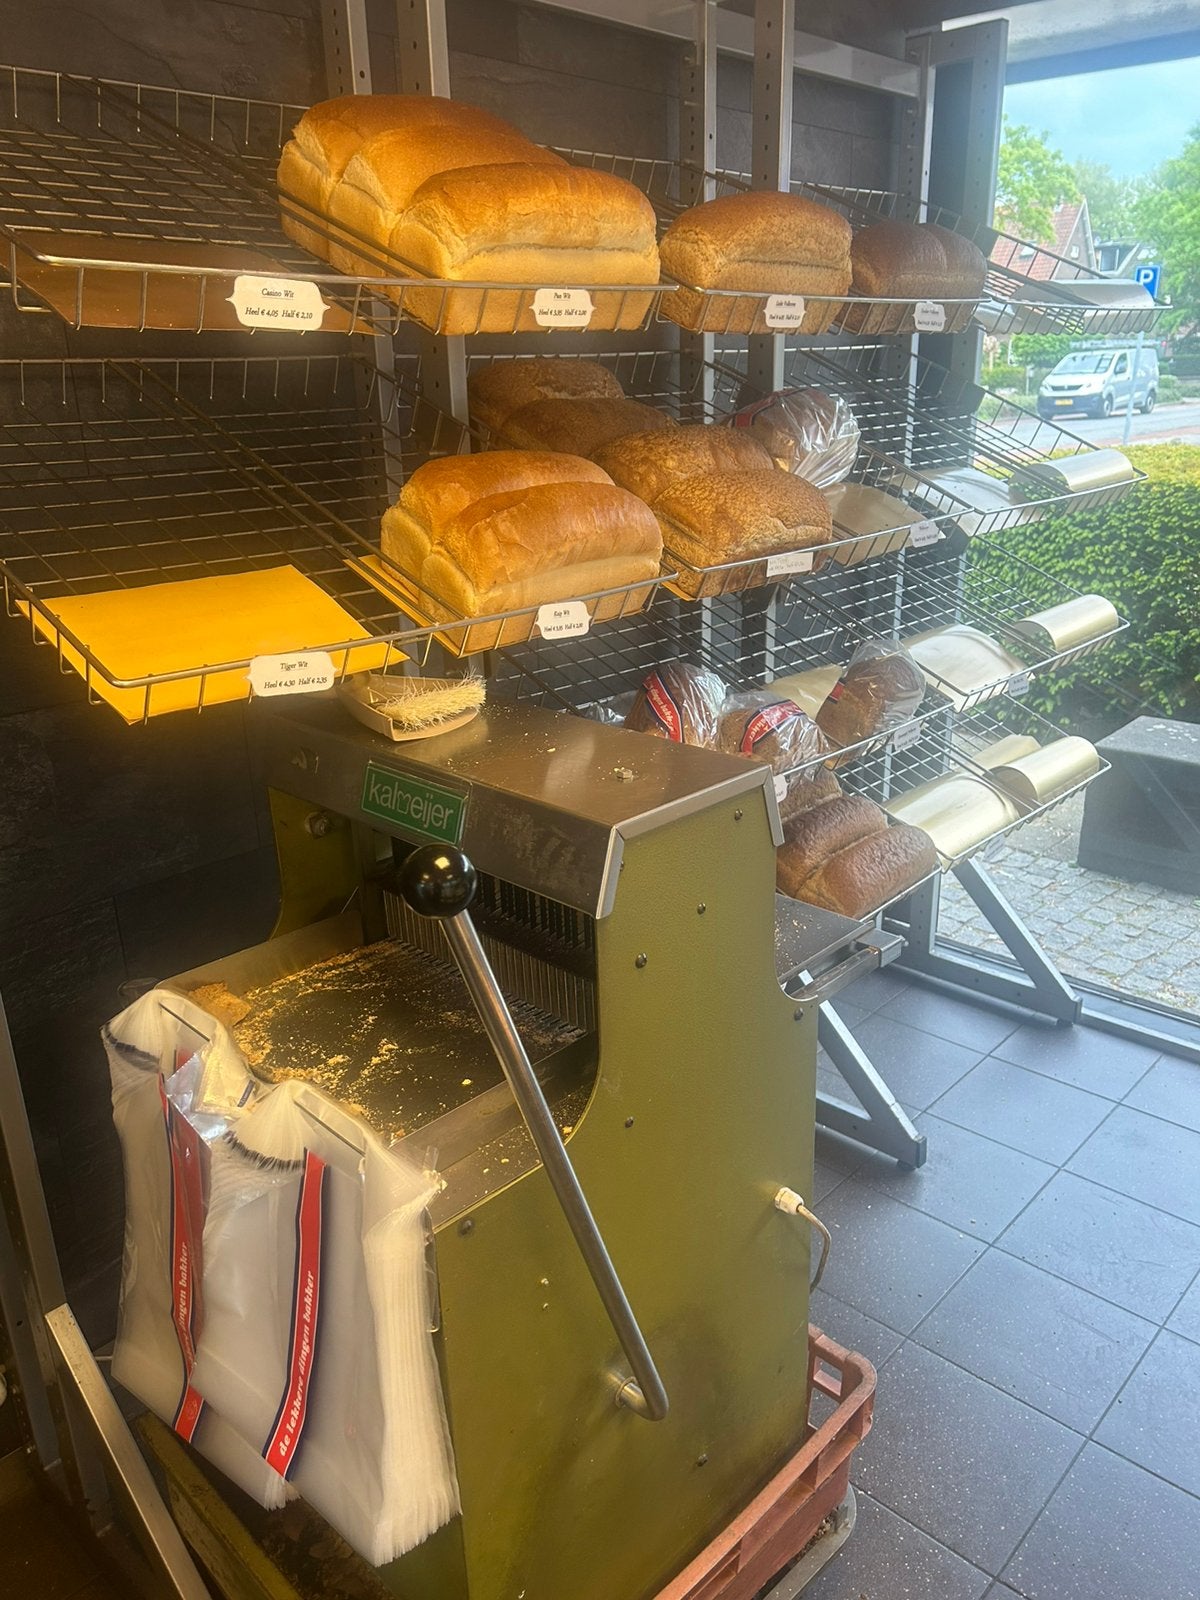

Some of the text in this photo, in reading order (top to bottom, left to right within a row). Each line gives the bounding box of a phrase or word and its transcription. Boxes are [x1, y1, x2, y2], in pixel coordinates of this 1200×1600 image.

[1138, 270, 1154, 286] P
[262, 288, 294, 298] Casino Wit
[245, 307, 259, 316] Heel
[282, 310, 296, 318] Half
[264, 681, 277, 689] Heel
[298, 677, 311, 686] Half
[178, 1242, 188, 1288] bakker
[278, 1270, 315, 1457] de lekkere dingen bakker
